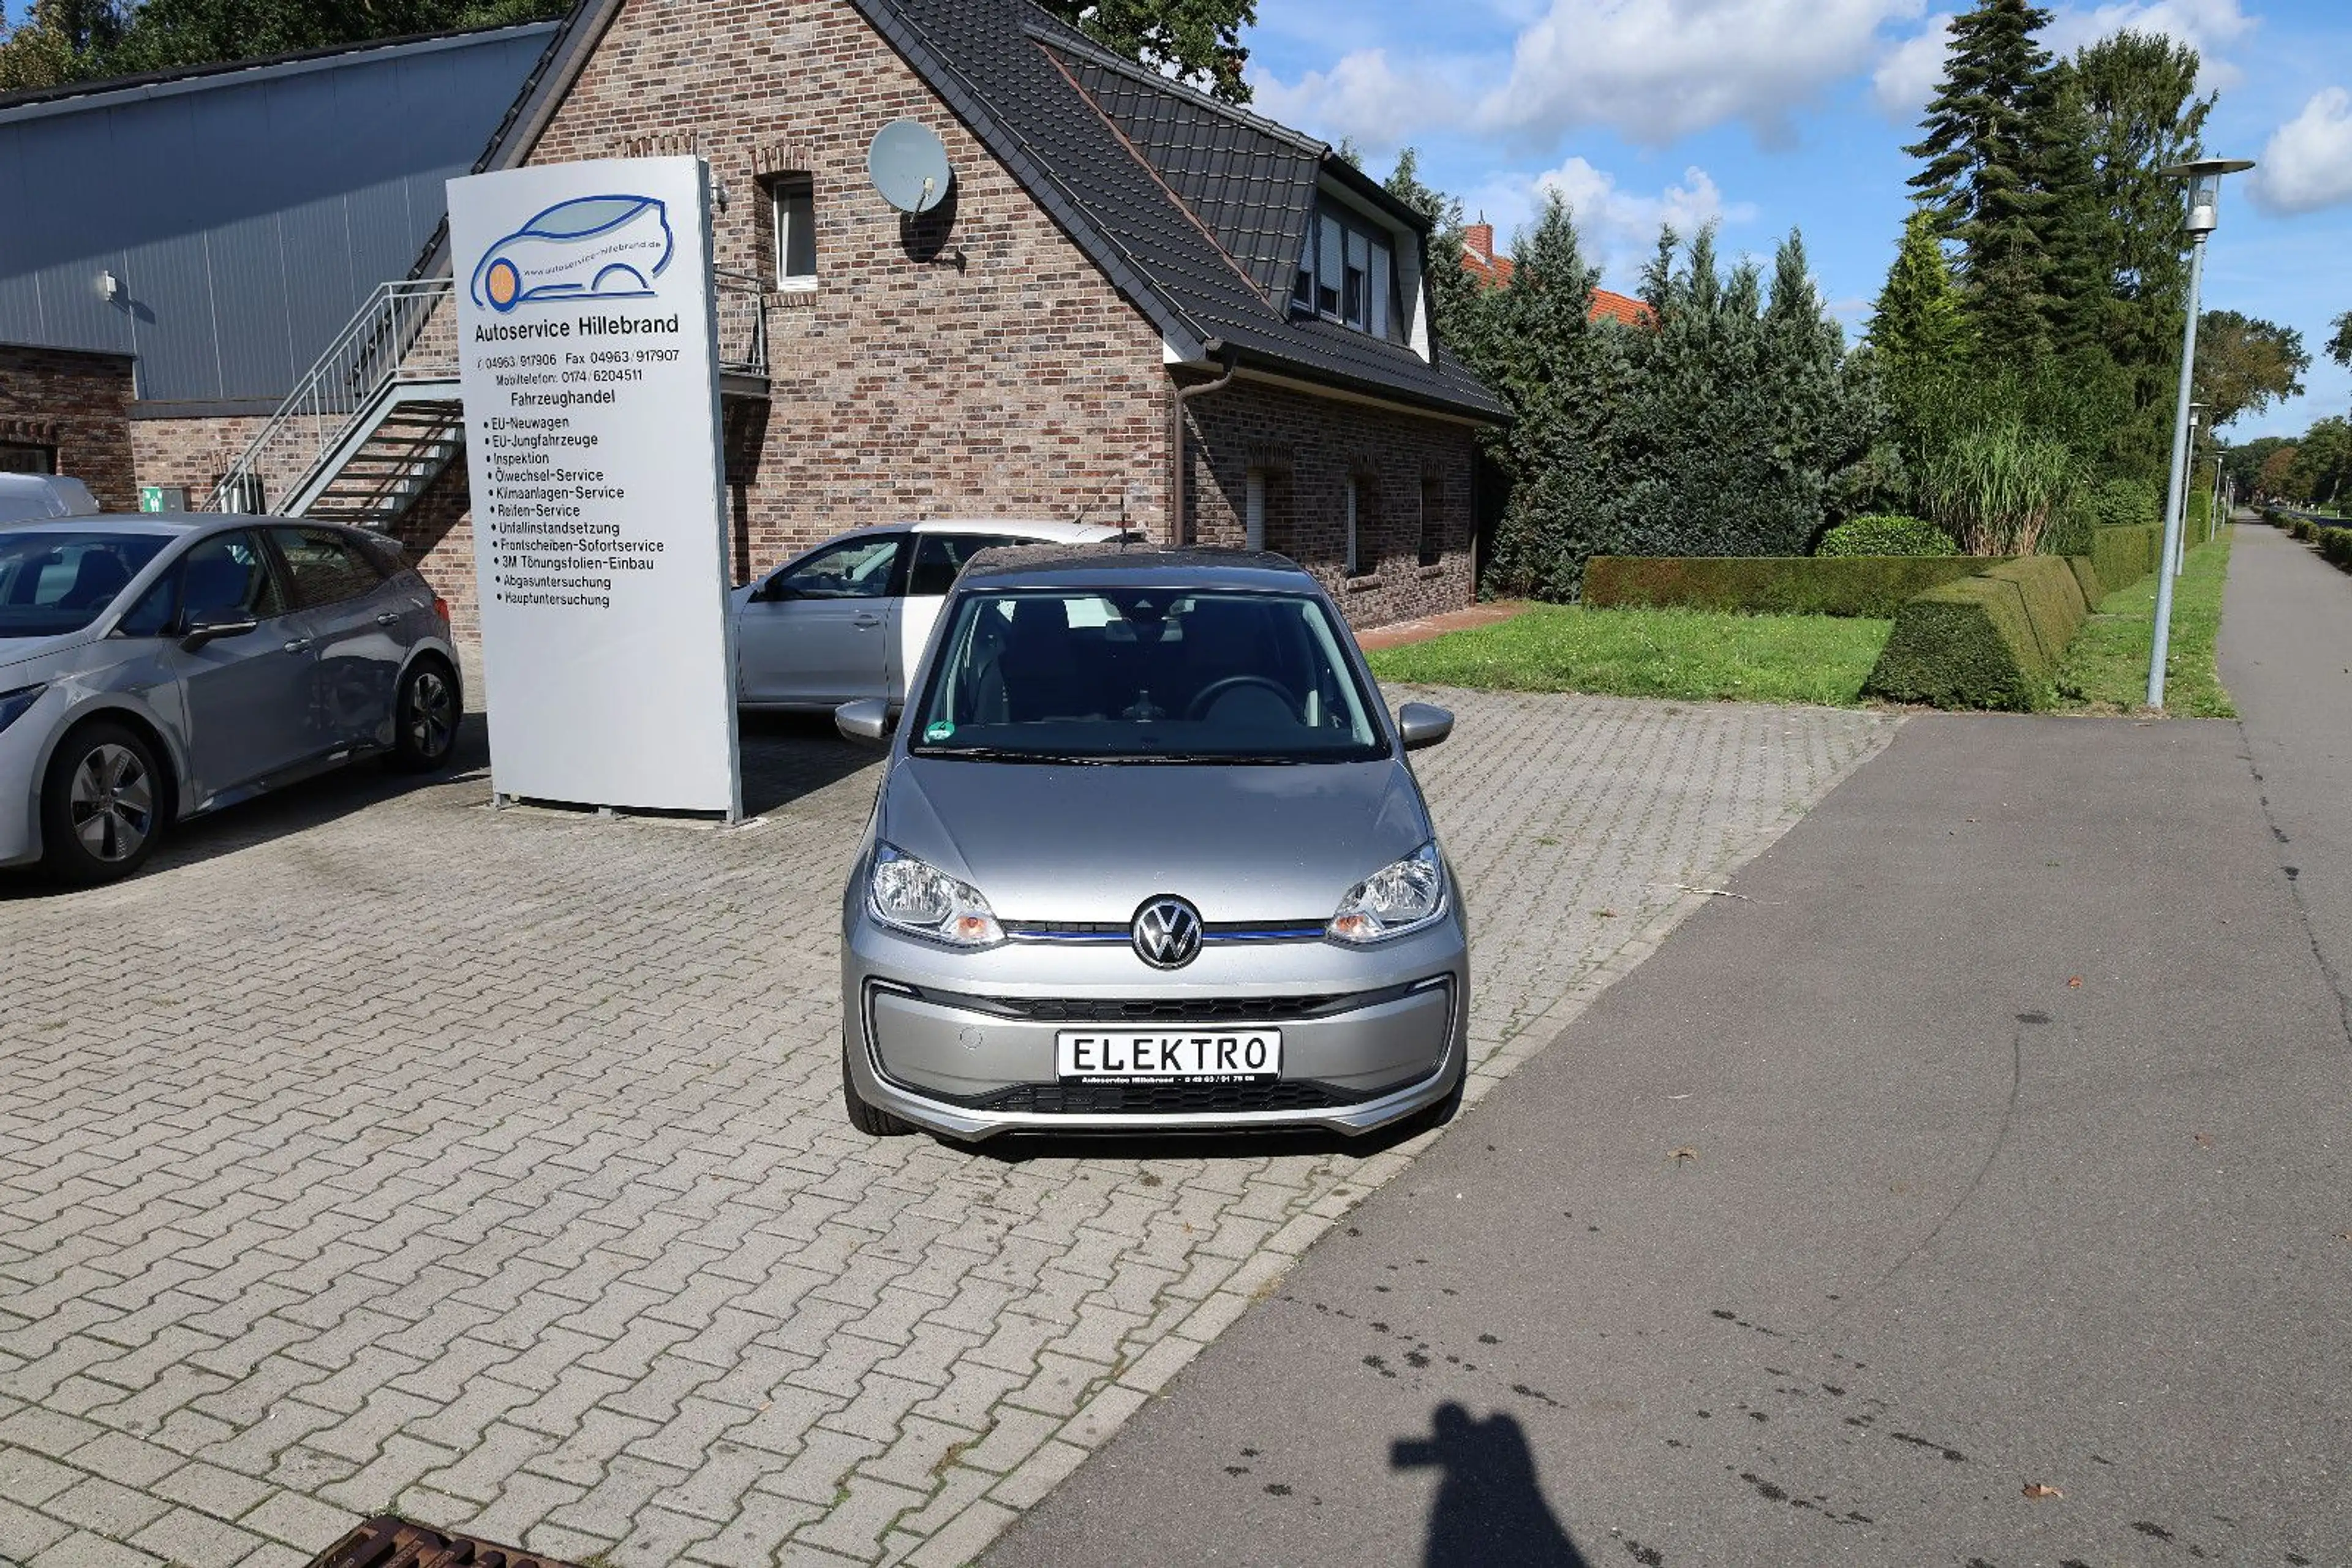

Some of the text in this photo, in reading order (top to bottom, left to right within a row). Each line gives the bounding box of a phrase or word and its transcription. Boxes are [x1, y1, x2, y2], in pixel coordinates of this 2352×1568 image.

[475, 314, 679, 342] Autoservice Hillebrand
[565, 352, 586, 364] Fax
[511, 389, 616, 409] Fahrzeughandel
[491, 417, 570, 431] EU-Neuwagen
[492, 434, 598, 449] EU-Jungfahrzeuge
[493, 451, 549, 466] Inspektion
[495, 467, 604, 483] Ölwechsel-Service
[496, 486, 625, 502] Klimaanlagen-Service
[497, 504, 581, 517] Reifen-Service
[499, 522, 620, 538] Unfallinstandsetzung
[500, 538, 664, 552] Frontscheiben-Sofortservice
[502, 556, 654, 571] 3M Tönungsfolien-Einbau
[503, 575, 611, 591] Abgasuntersuchung
[505, 592, 610, 609] Hauptuntersuchung
[1073, 1037, 1267, 1071] ELEKTRO
